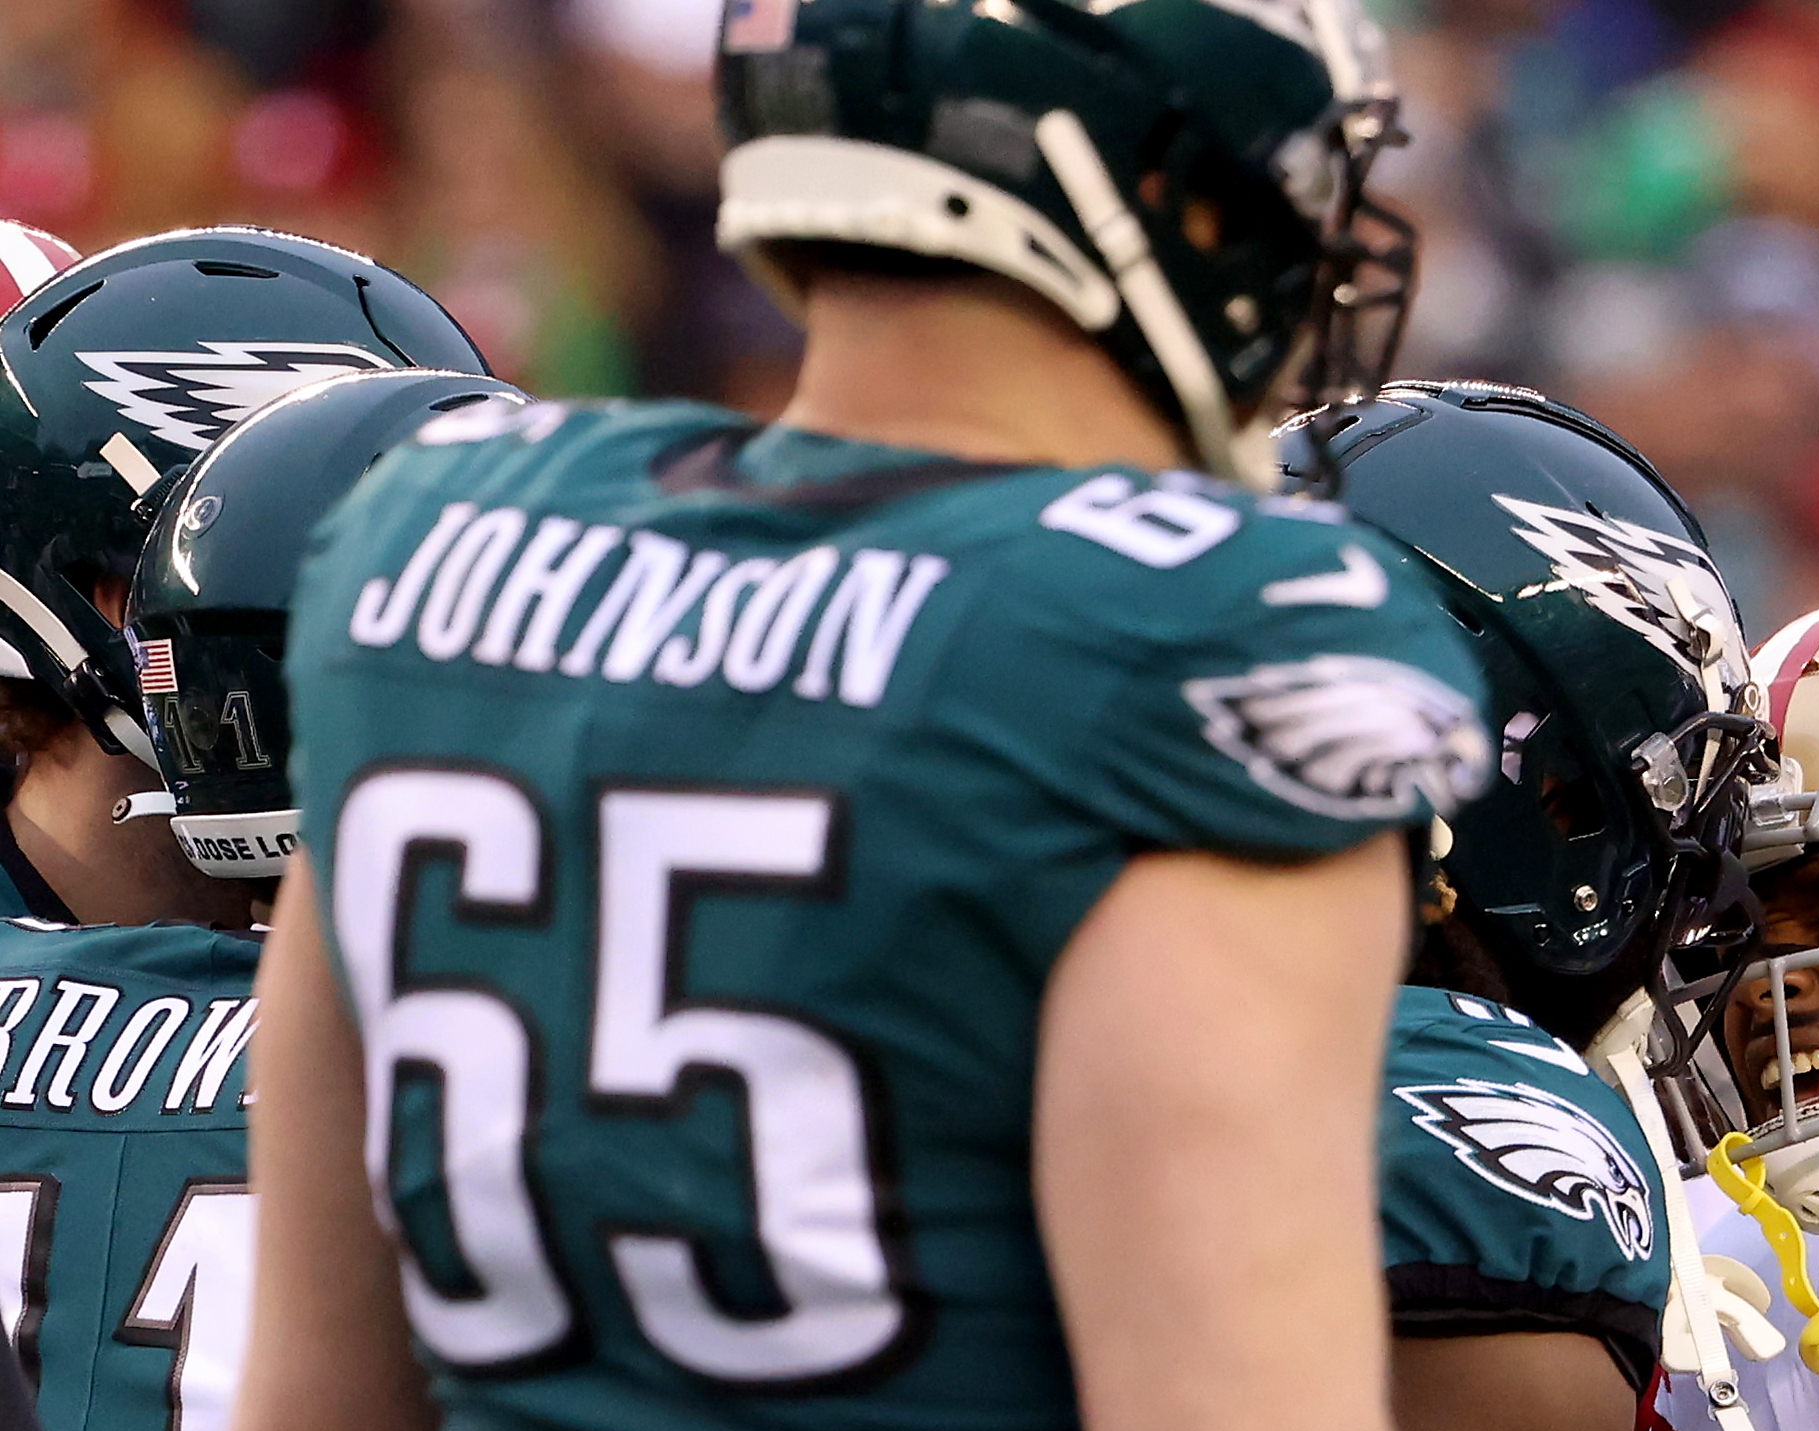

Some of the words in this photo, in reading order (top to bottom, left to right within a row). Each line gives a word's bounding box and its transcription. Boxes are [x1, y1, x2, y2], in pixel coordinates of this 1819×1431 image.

[348, 500, 950, 707] JOHNSON
[165, 691, 272, 774] 11
[0, 978, 262, 1114] ROW
[332, 760, 912, 1388] 65
